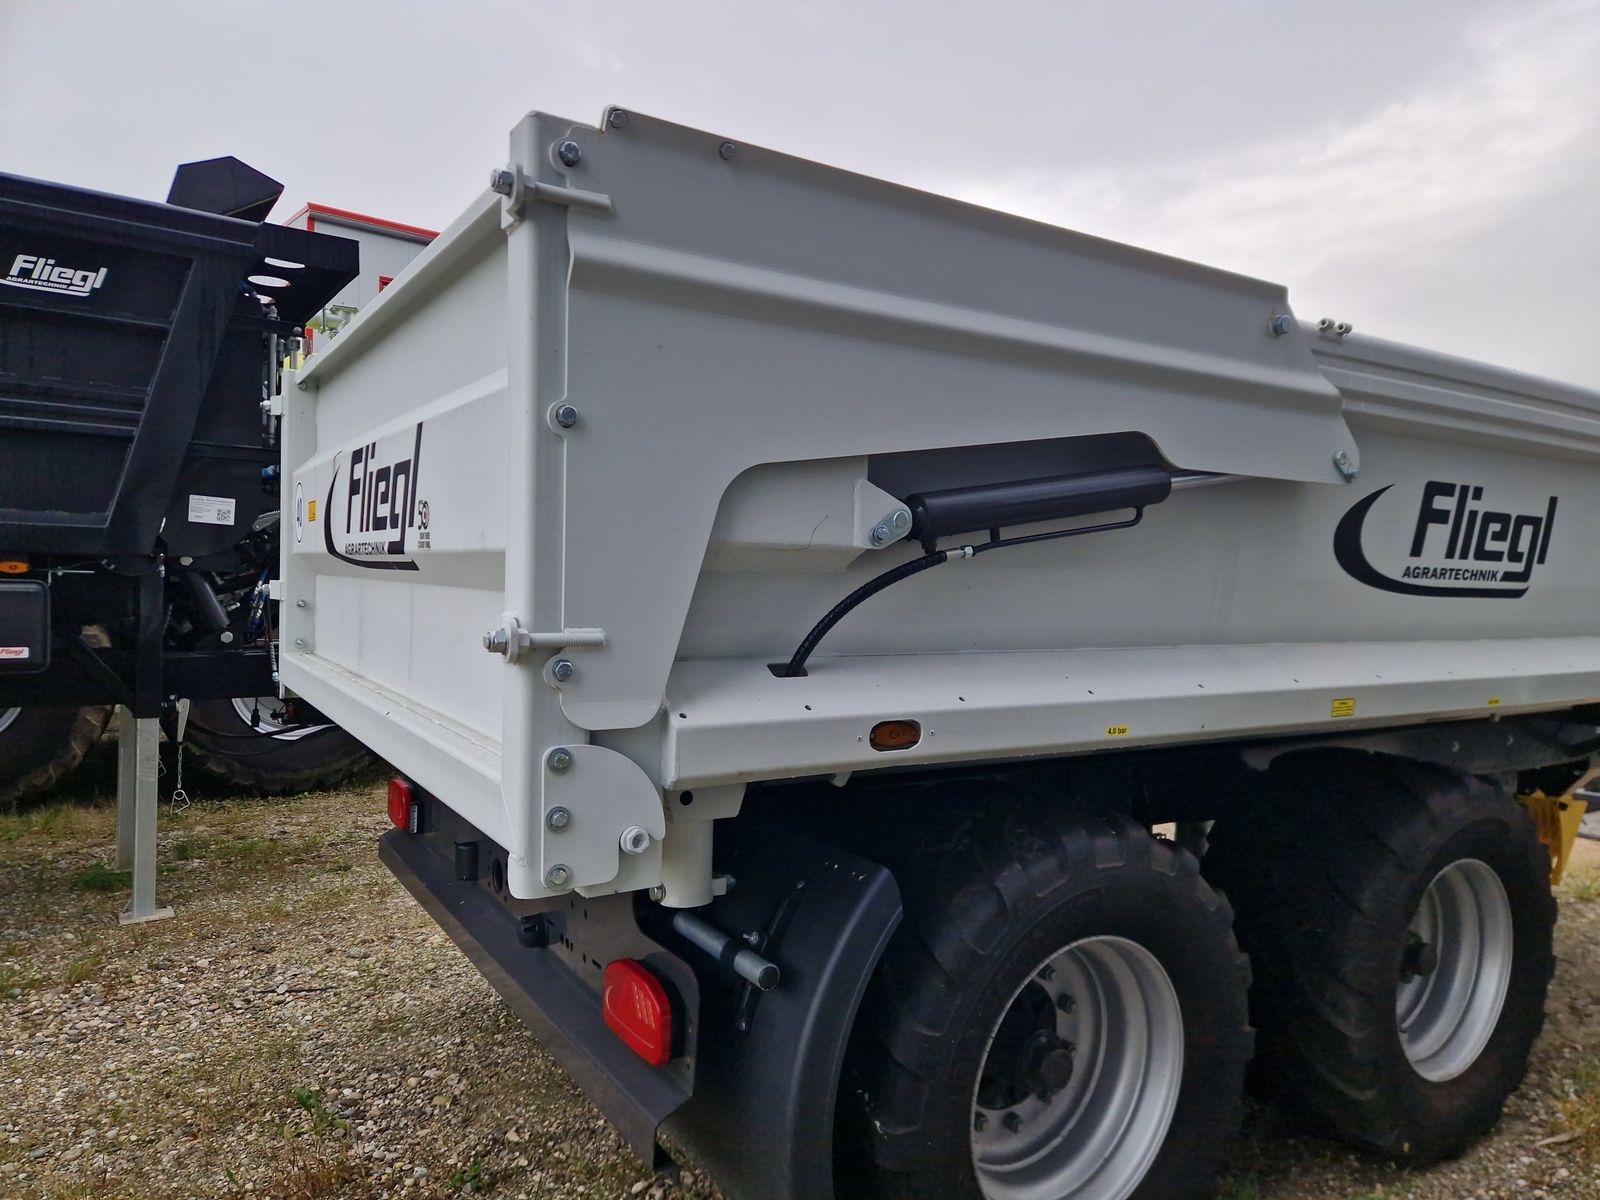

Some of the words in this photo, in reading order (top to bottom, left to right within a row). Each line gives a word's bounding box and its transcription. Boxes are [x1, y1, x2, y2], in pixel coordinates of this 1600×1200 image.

[9, 254, 108, 292] Fliegl
[6, 276, 68, 290] AGRARTECHNIK
[346, 421, 424, 555] Fliegl
[1409, 480, 1558, 583] Fliegl
[345, 541, 388, 556] AGRARTECHNIK
[1402, 566, 1500, 582] AGRARTECHNIK
[1117, 727, 1127, 735] bar
